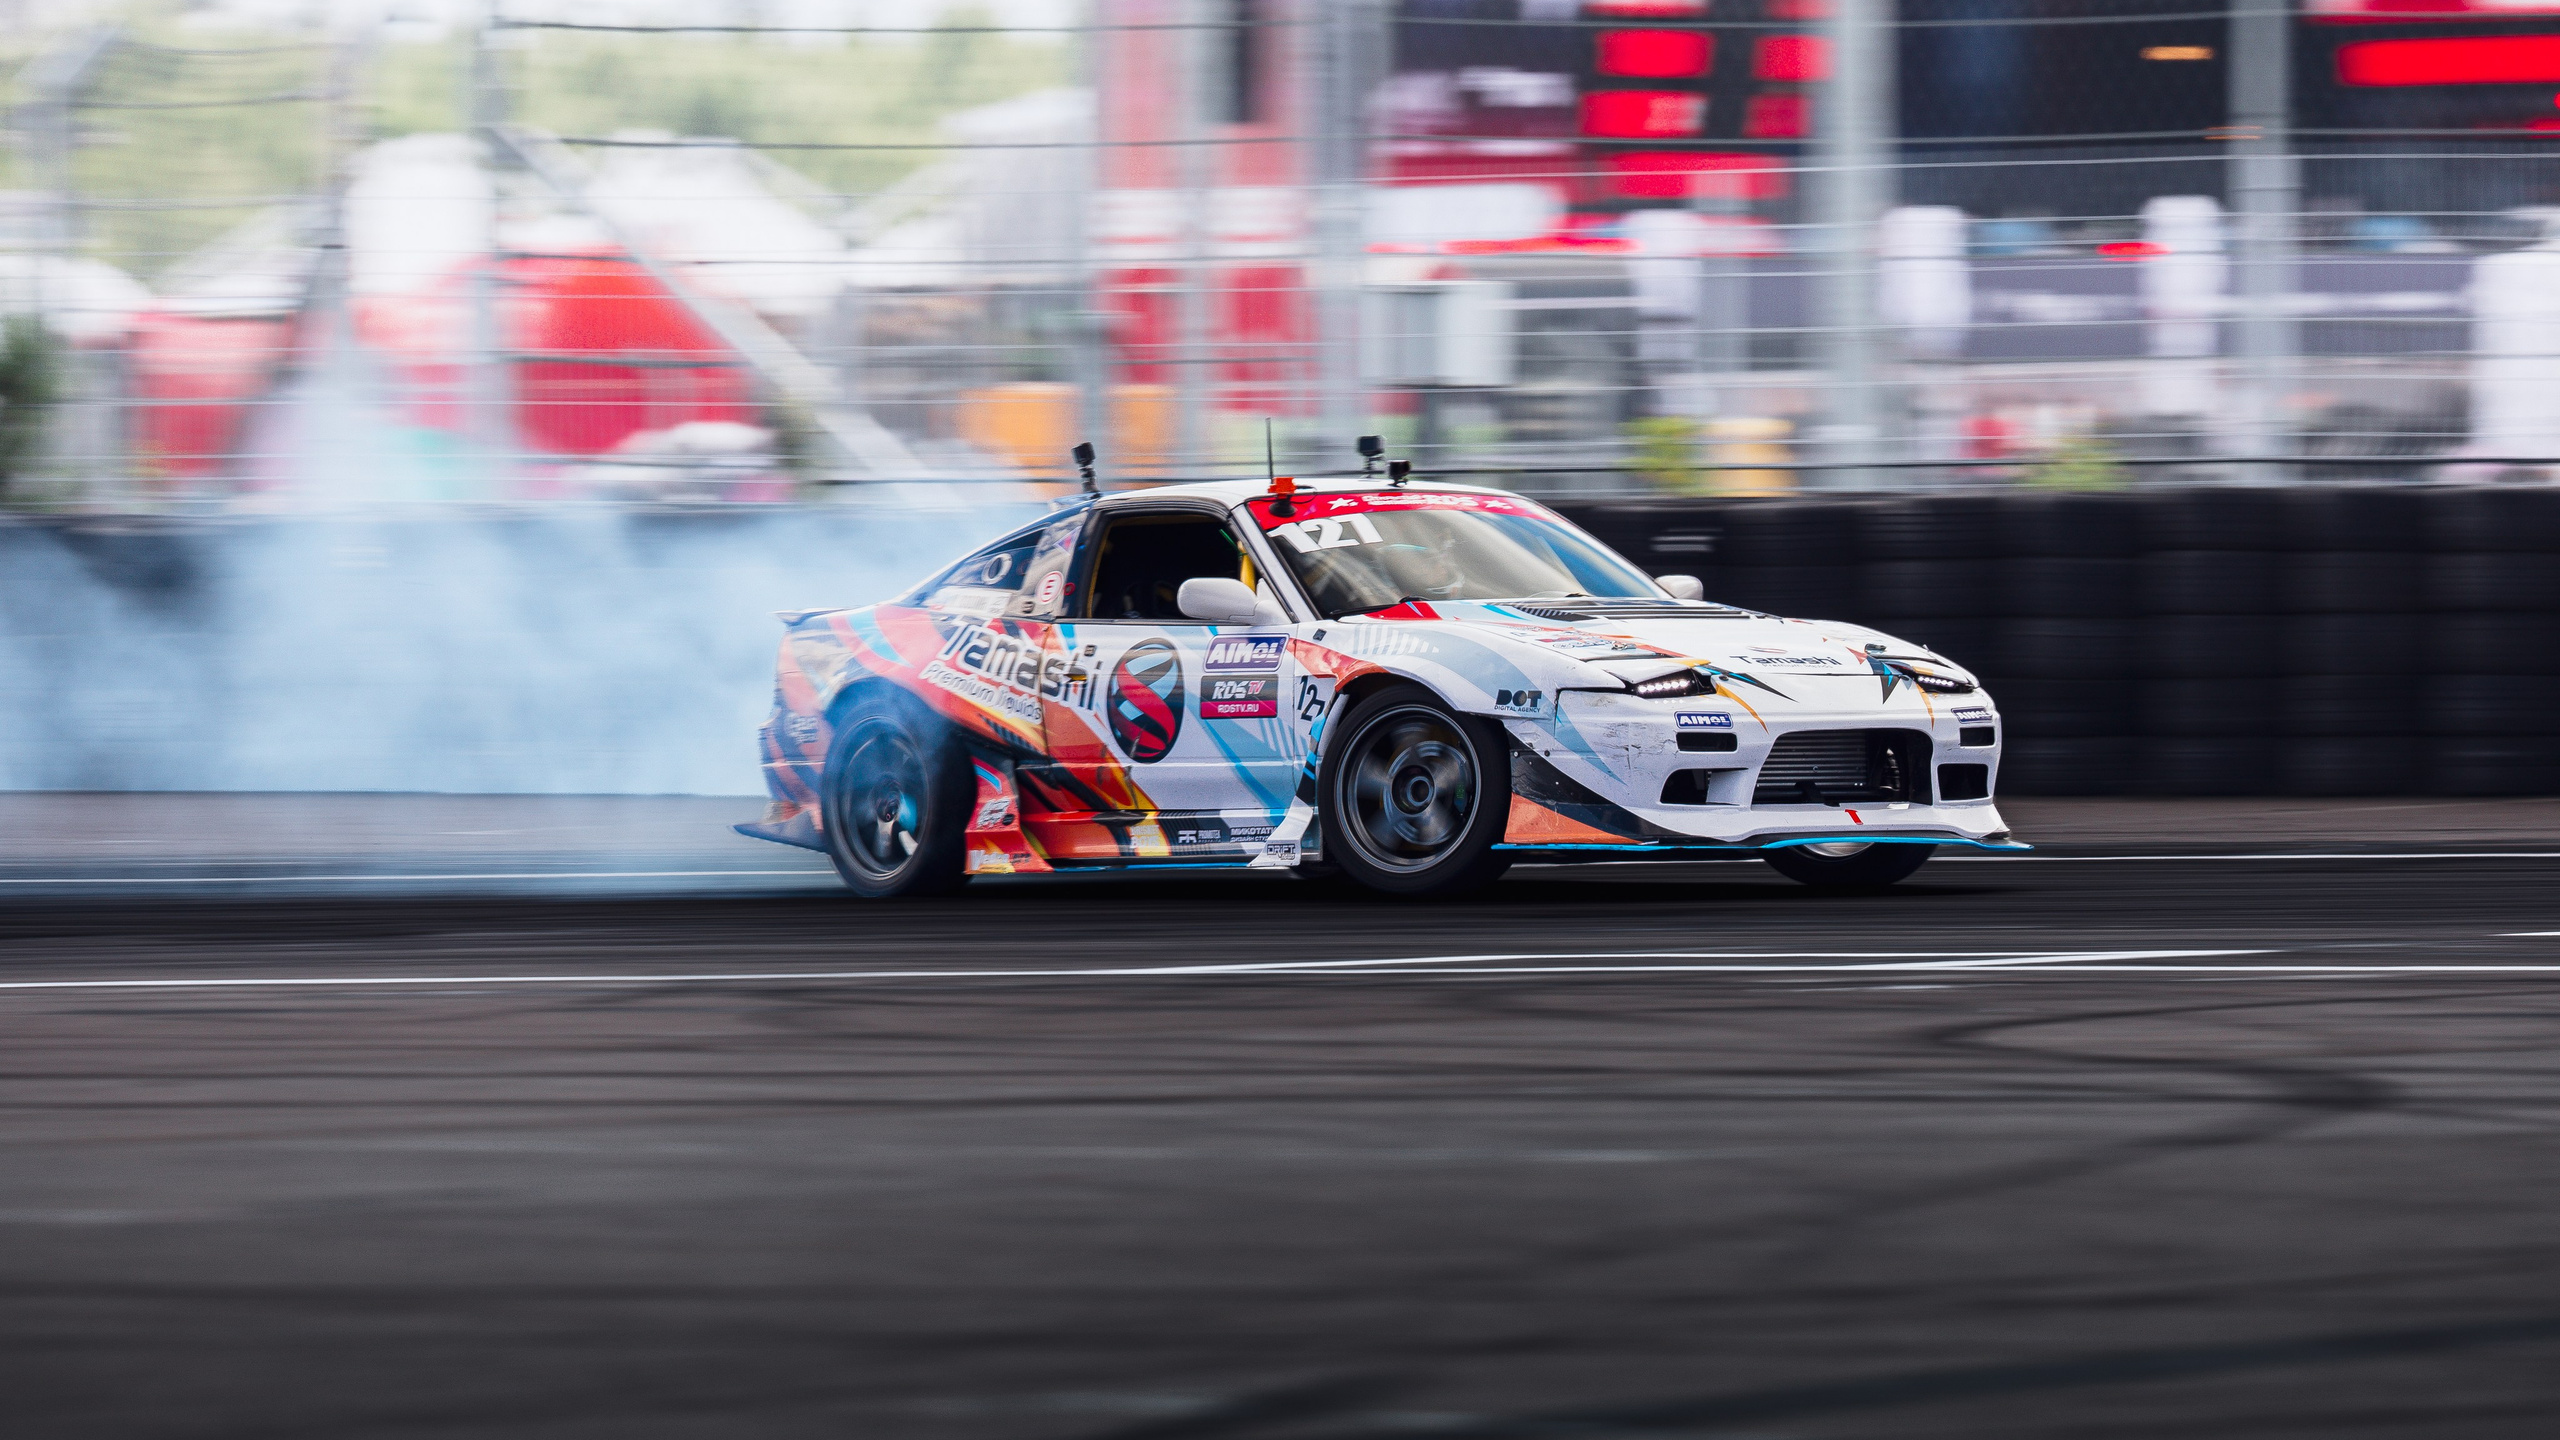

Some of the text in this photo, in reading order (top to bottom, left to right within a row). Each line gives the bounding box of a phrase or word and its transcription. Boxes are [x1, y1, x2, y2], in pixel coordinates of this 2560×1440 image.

[1266, 513, 1383, 553] 127
[939, 615, 1104, 711] Tamashi
[1206, 642, 1280, 664] AIMOL
[1729, 655, 1842, 665] Tamashi
[923, 660, 996, 704] Premium
[1496, 689, 1542, 707] DOT
[1217, 703, 1259, 714] RDSTV.RU
[1679, 715, 1730, 725] AIMOL
